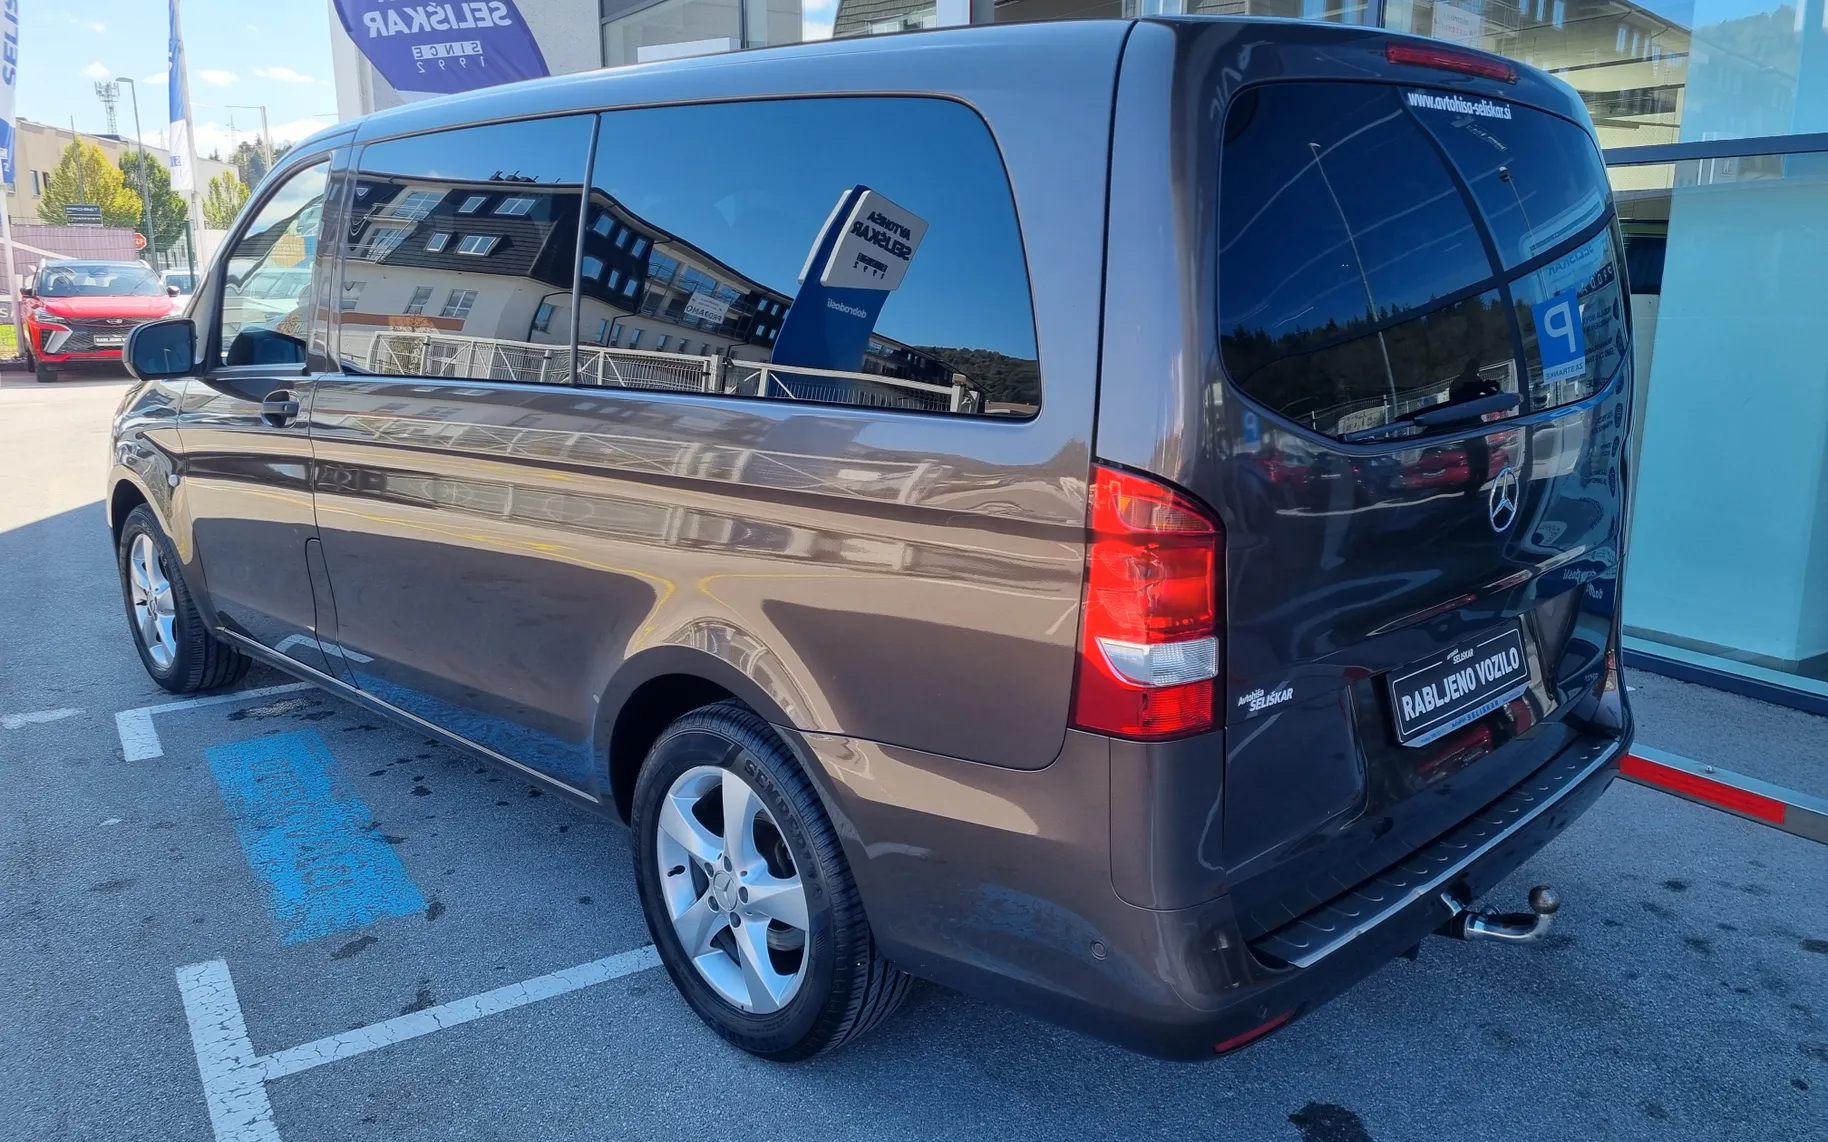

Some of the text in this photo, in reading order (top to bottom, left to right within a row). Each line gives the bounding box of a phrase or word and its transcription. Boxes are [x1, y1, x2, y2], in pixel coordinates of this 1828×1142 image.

[1408, 92, 1512, 120] www.avtohisa-seliskar.si
[1401, 647, 1520, 721] RABLJENO VOZILO
[1249, 687, 1294, 712] SELIŠKAR
